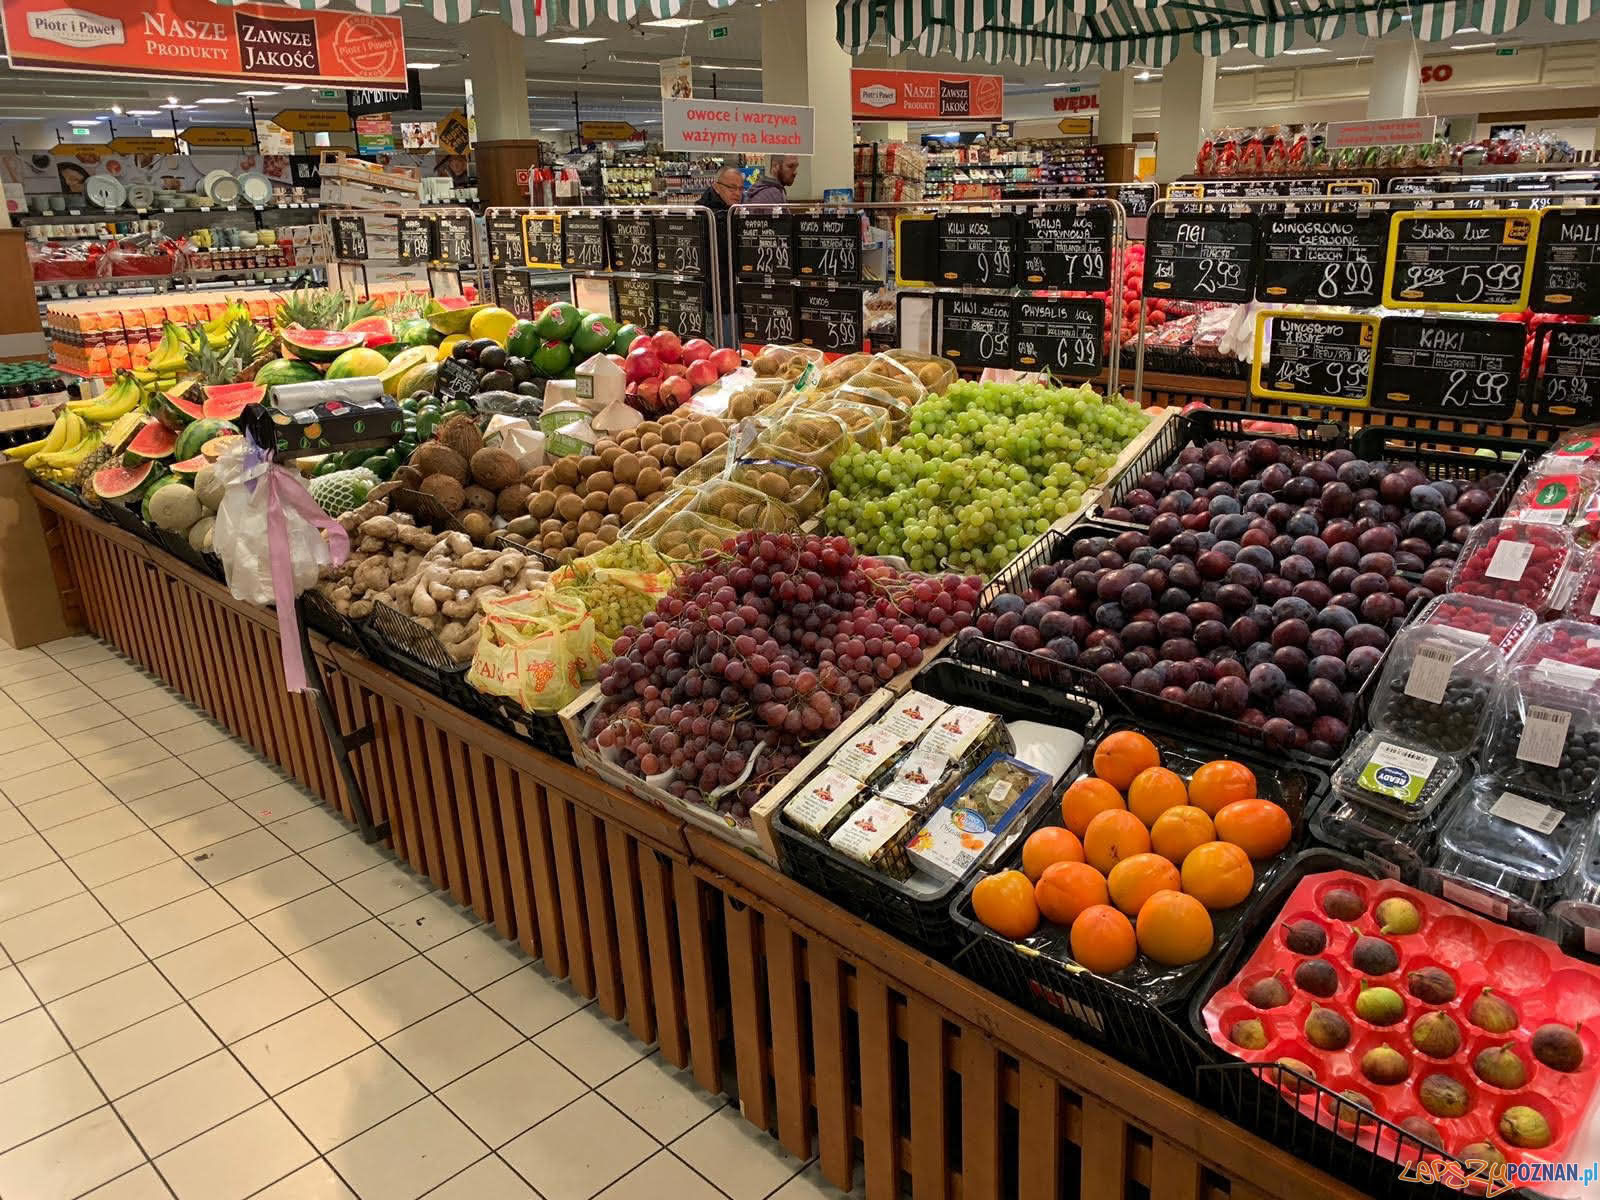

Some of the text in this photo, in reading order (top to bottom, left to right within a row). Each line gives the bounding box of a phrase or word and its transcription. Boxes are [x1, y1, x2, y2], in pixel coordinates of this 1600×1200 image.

[34, 18, 67, 32] Piotr
[71, 22, 76, 33] i
[141, 11, 228, 42] NASZE
[242, 25, 312, 48] ZAWSZE
[146, 40, 229, 60] PRODUKTY
[246, 47, 315, 70] JAKOŚĆ
[903, 82, 936, 99] NASZE
[941, 87, 968, 99] ZAWSZE
[903, 101, 937, 111] PRODUKTY
[941, 98, 969, 113] JAKOŚĆ
[687, 107, 798, 128] owoce i warzywa
[682, 127, 802, 146] ważymy na kasach
[947, 223, 966, 235] KIWI
[1028, 218, 1062, 230] TRAWA
[1271, 222, 1354, 234] WINOGRONO
[1176, 223, 1205, 245] FIGI
[1298, 234, 1360, 246] CZERWONE
[953, 300, 977, 314] KIWI
[1021, 303, 1068, 319] PHYSALIS
[1280, 319, 1344, 337] WINOGRONO
[1418, 327, 1465, 352] KAKI
